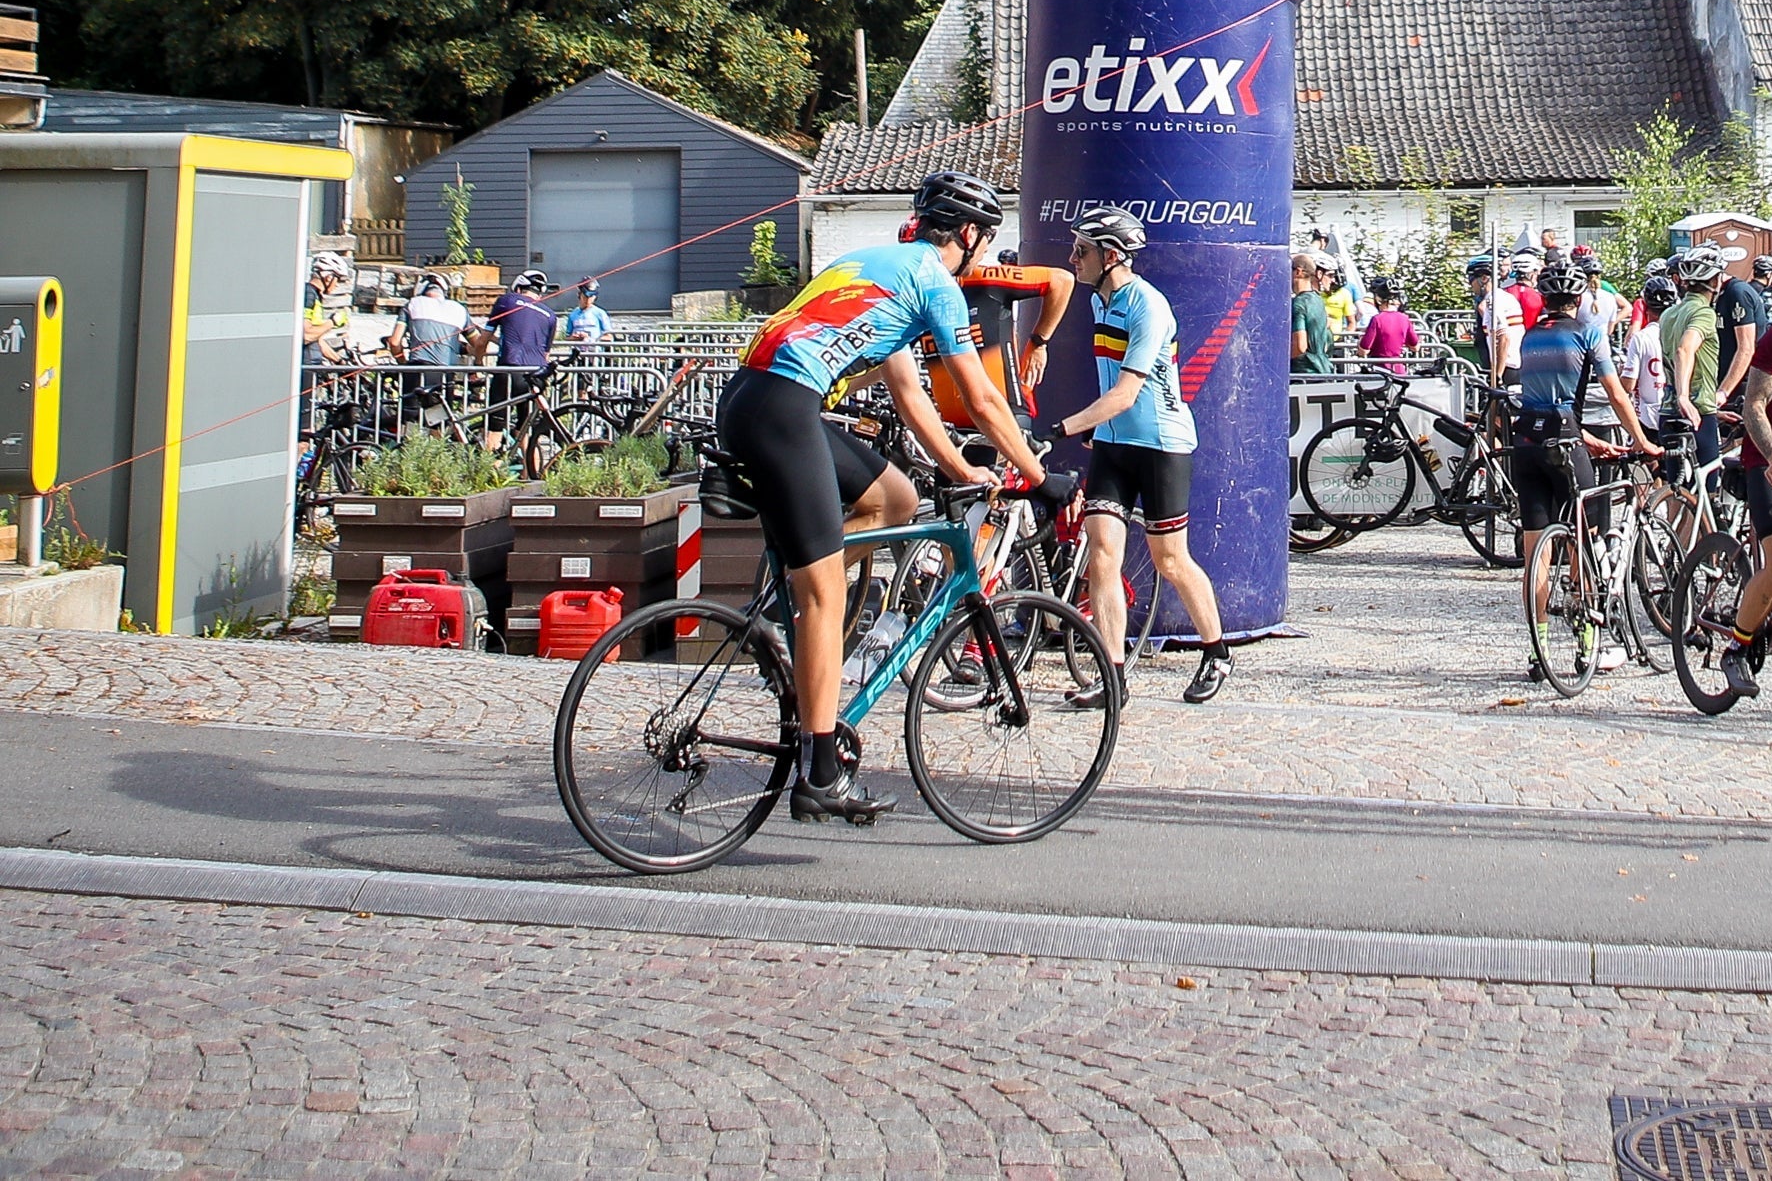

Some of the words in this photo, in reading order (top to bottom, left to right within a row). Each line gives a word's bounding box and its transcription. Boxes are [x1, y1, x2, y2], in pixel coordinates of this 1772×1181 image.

[1043, 37, 1244, 115] etixx
[1056, 120, 1122, 134] sports
[1135, 120, 1238, 134] nutrition
[820, 321, 878, 371] RTBF
[867, 587, 952, 708] RIDLEY
